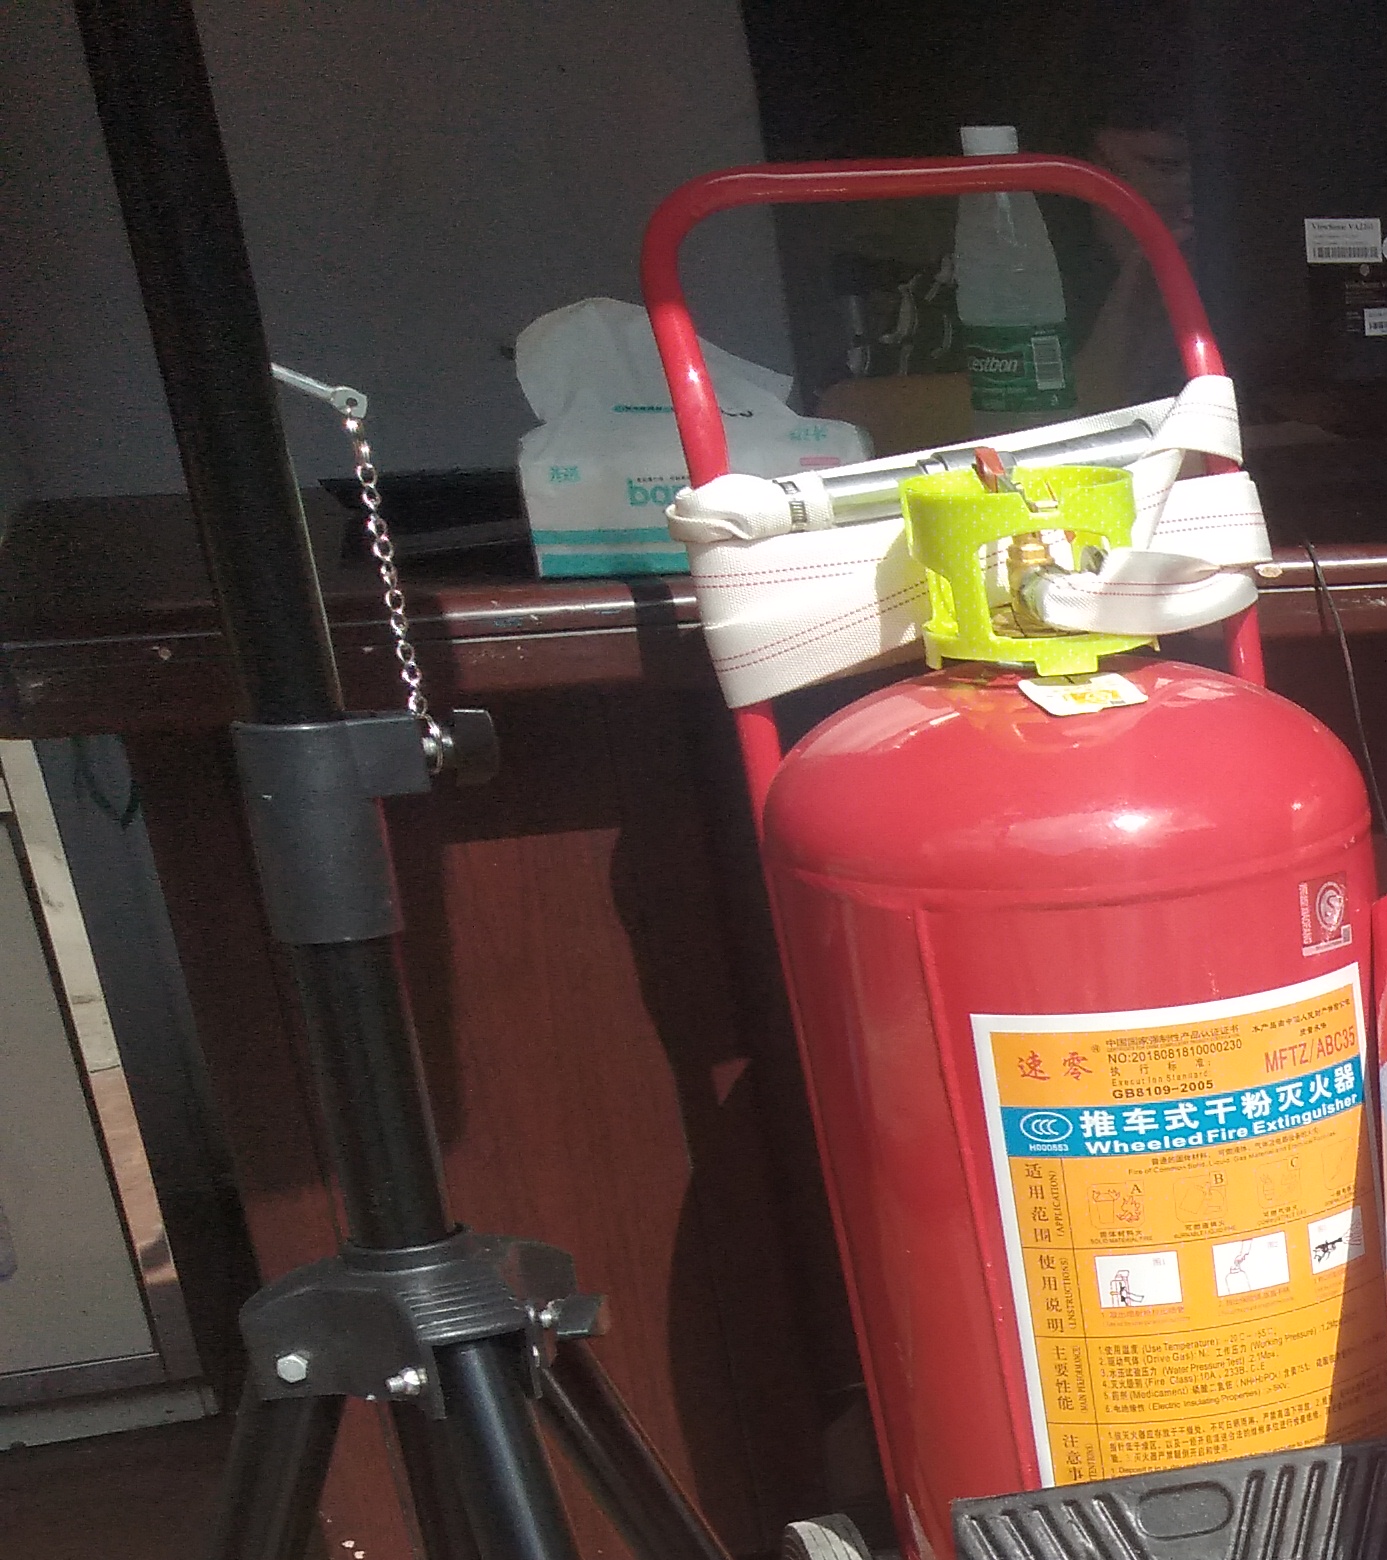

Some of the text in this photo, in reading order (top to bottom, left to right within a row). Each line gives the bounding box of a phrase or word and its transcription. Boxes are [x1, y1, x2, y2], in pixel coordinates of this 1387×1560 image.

[1079, 1063, 1355, 1139] 推车式干粉灭火器
[1112, 1079, 1214, 1100] GB8109-2005
[1085, 1093, 1357, 1155] Wheeled Fire Extinguisher
